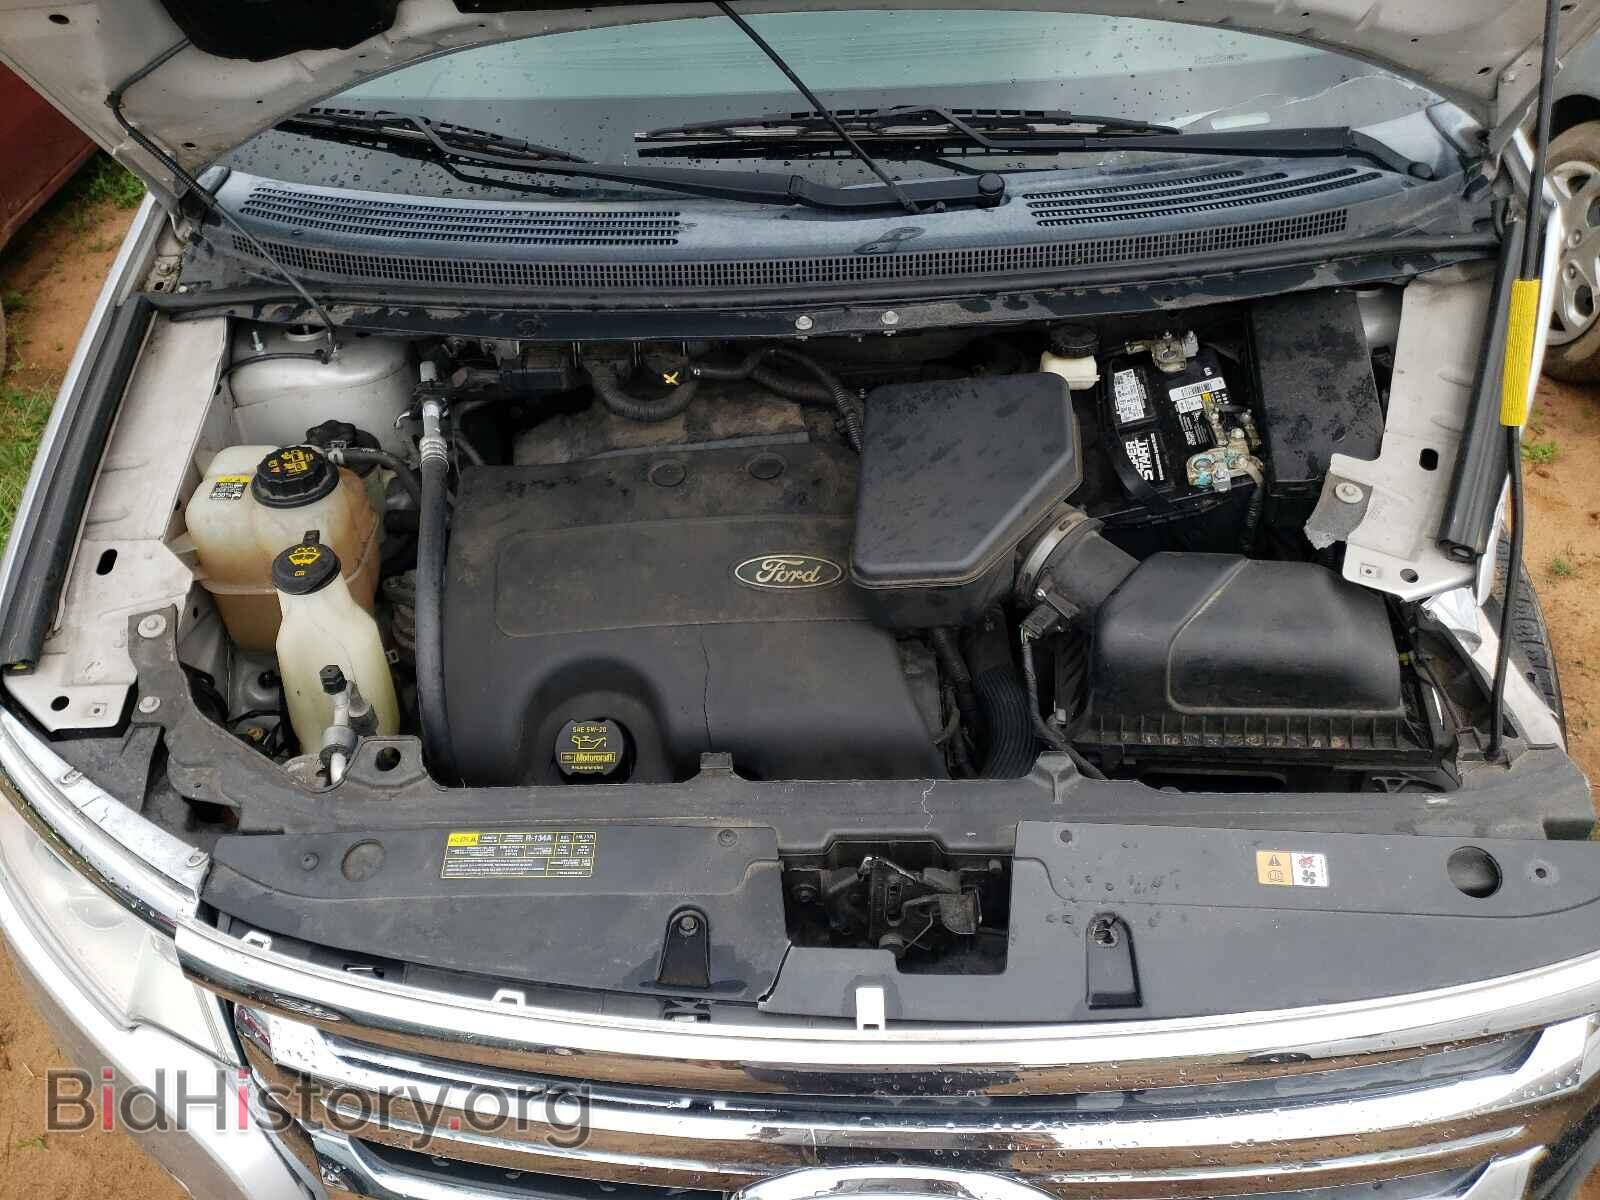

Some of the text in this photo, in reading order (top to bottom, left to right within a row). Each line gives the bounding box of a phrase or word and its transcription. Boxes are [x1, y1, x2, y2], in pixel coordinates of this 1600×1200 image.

[1134, 439, 1153, 480] START
[756, 559, 821, 582] Ford
[575, 752, 613, 762] Motorcraft
[525, 834, 552, 842] R-134A
